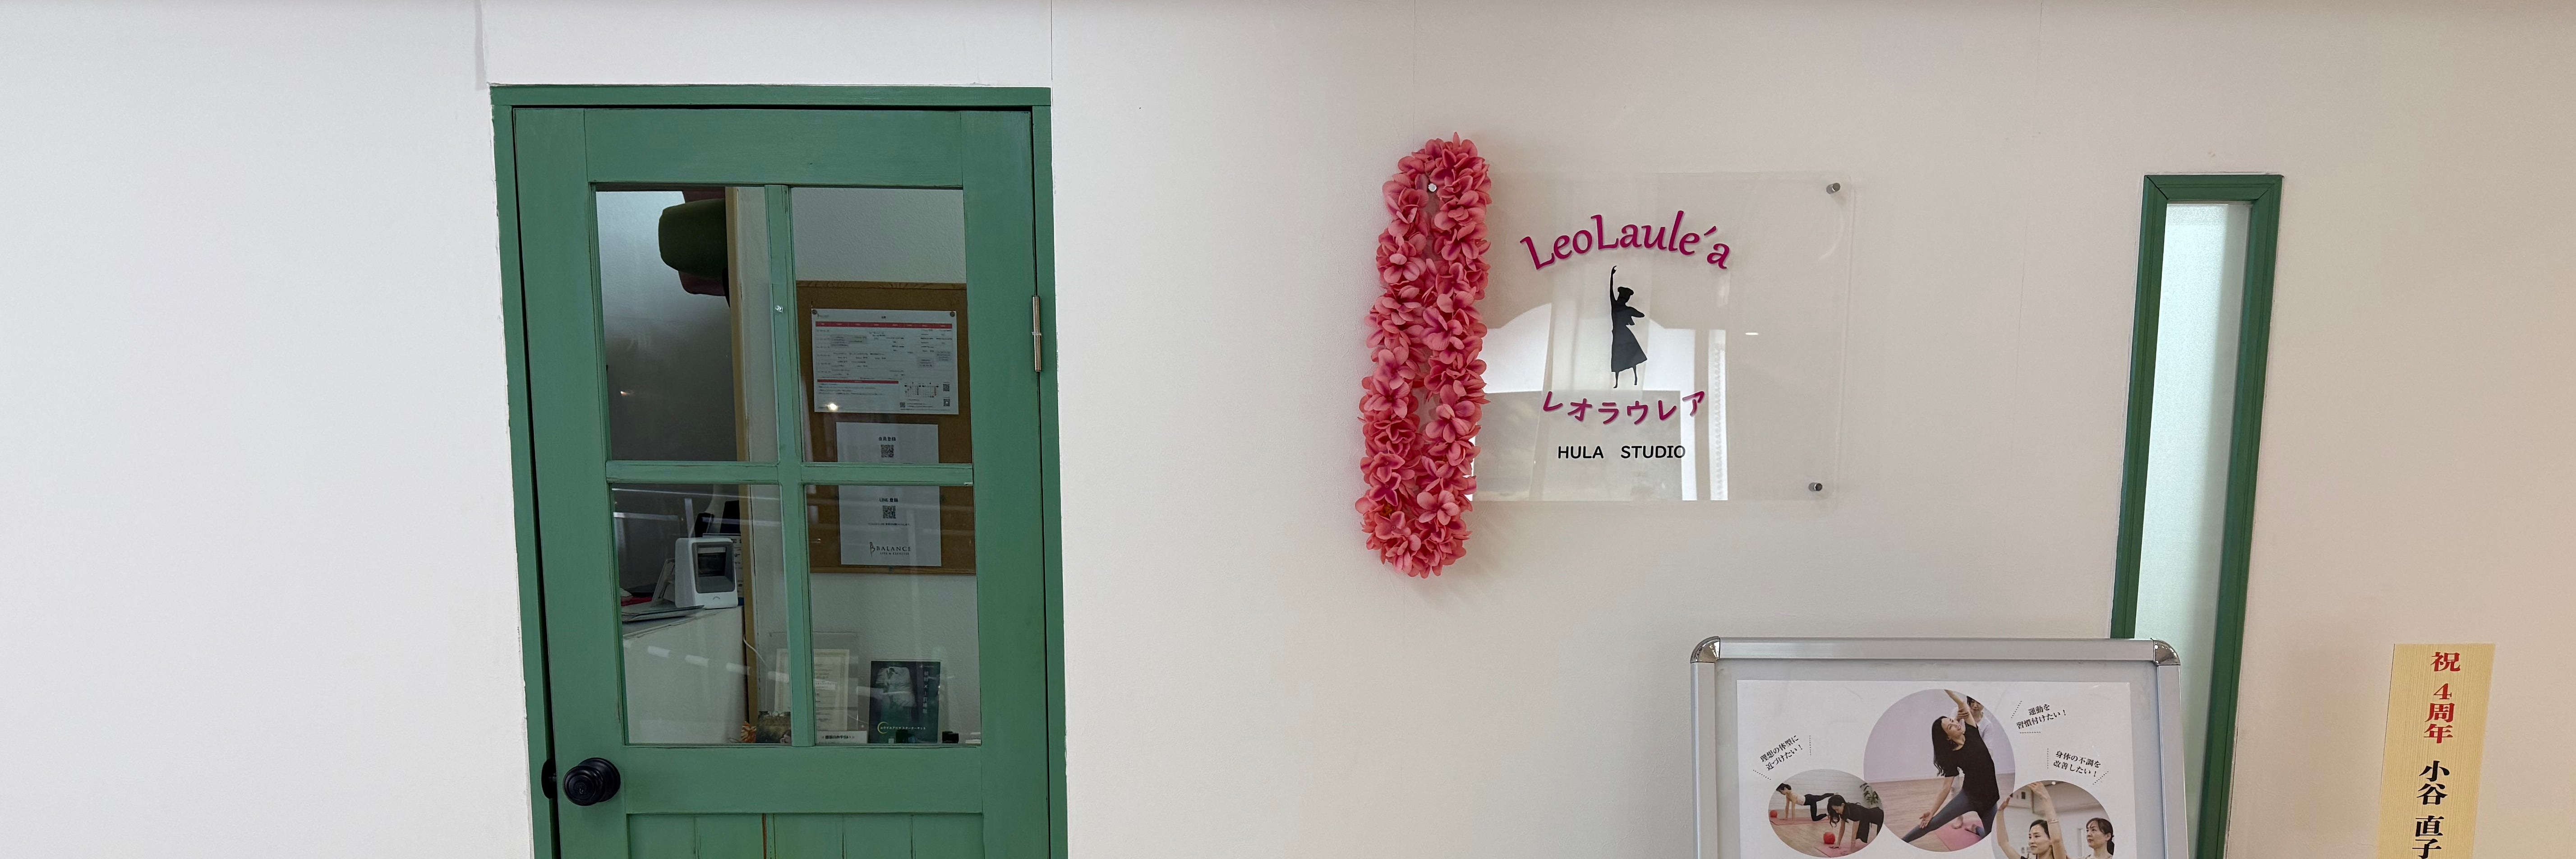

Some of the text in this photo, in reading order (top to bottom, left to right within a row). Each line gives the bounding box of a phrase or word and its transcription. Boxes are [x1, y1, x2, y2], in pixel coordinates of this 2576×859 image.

[1542, 391, 1705, 425] レオラウレア
[1558, 445, 1686, 459] HULA STUDIO
[2028, 704, 2050, 716] 運動を
[1760, 735, 1799, 762] 理想の体型に
[2055, 751, 2101, 768] 身体の不調を
[2412, 651, 2461, 859] 祝 4周年 小谷 直子
